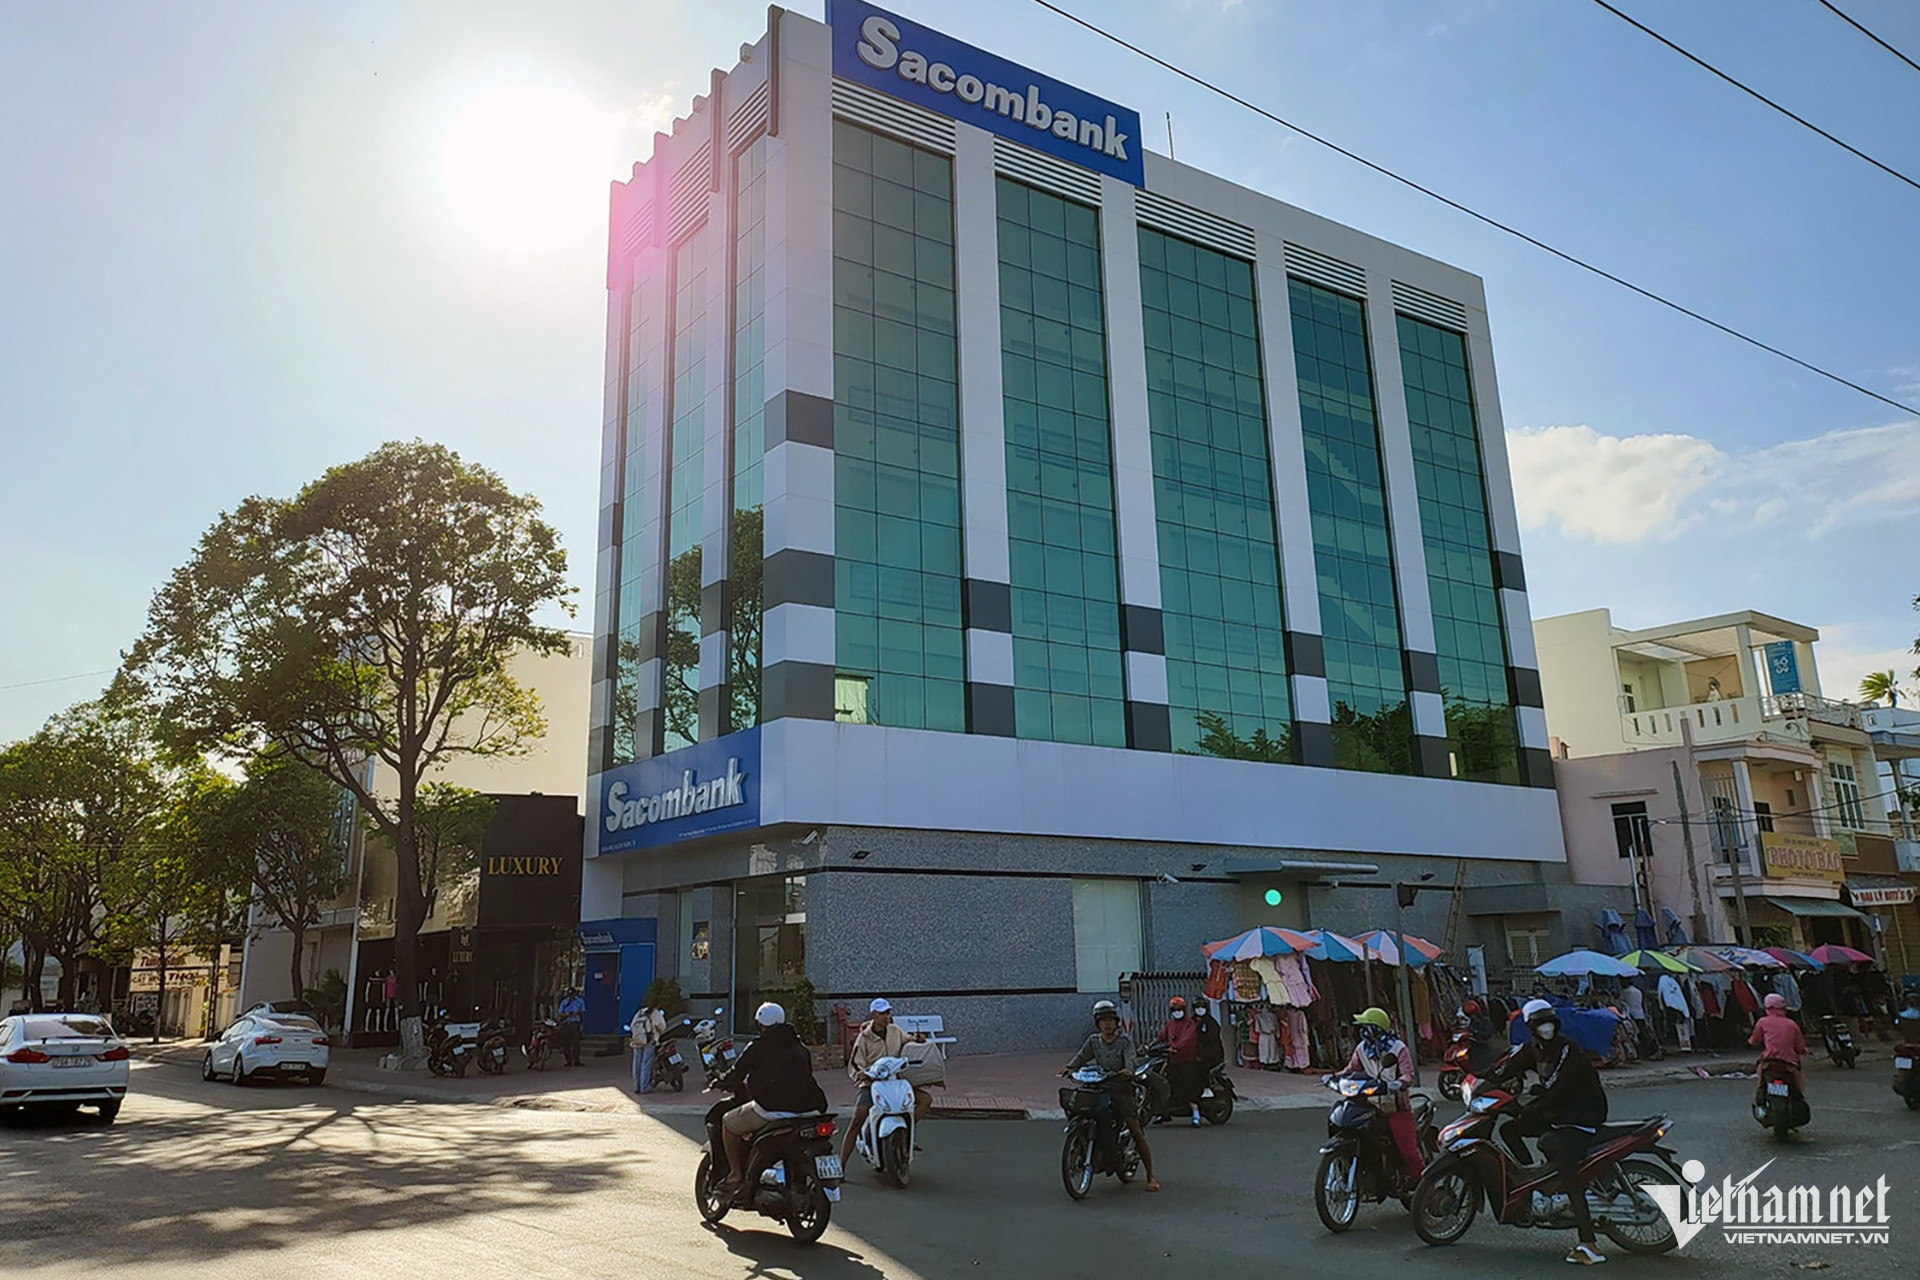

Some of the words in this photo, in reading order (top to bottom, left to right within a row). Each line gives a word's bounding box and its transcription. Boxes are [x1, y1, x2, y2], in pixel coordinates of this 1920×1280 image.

[856, 15, 1130, 161] Sacombank
[606, 757, 746, 832] Sacombank
[488, 856, 562, 875] LUXURY
[1768, 846, 1814, 869] PHOTO
